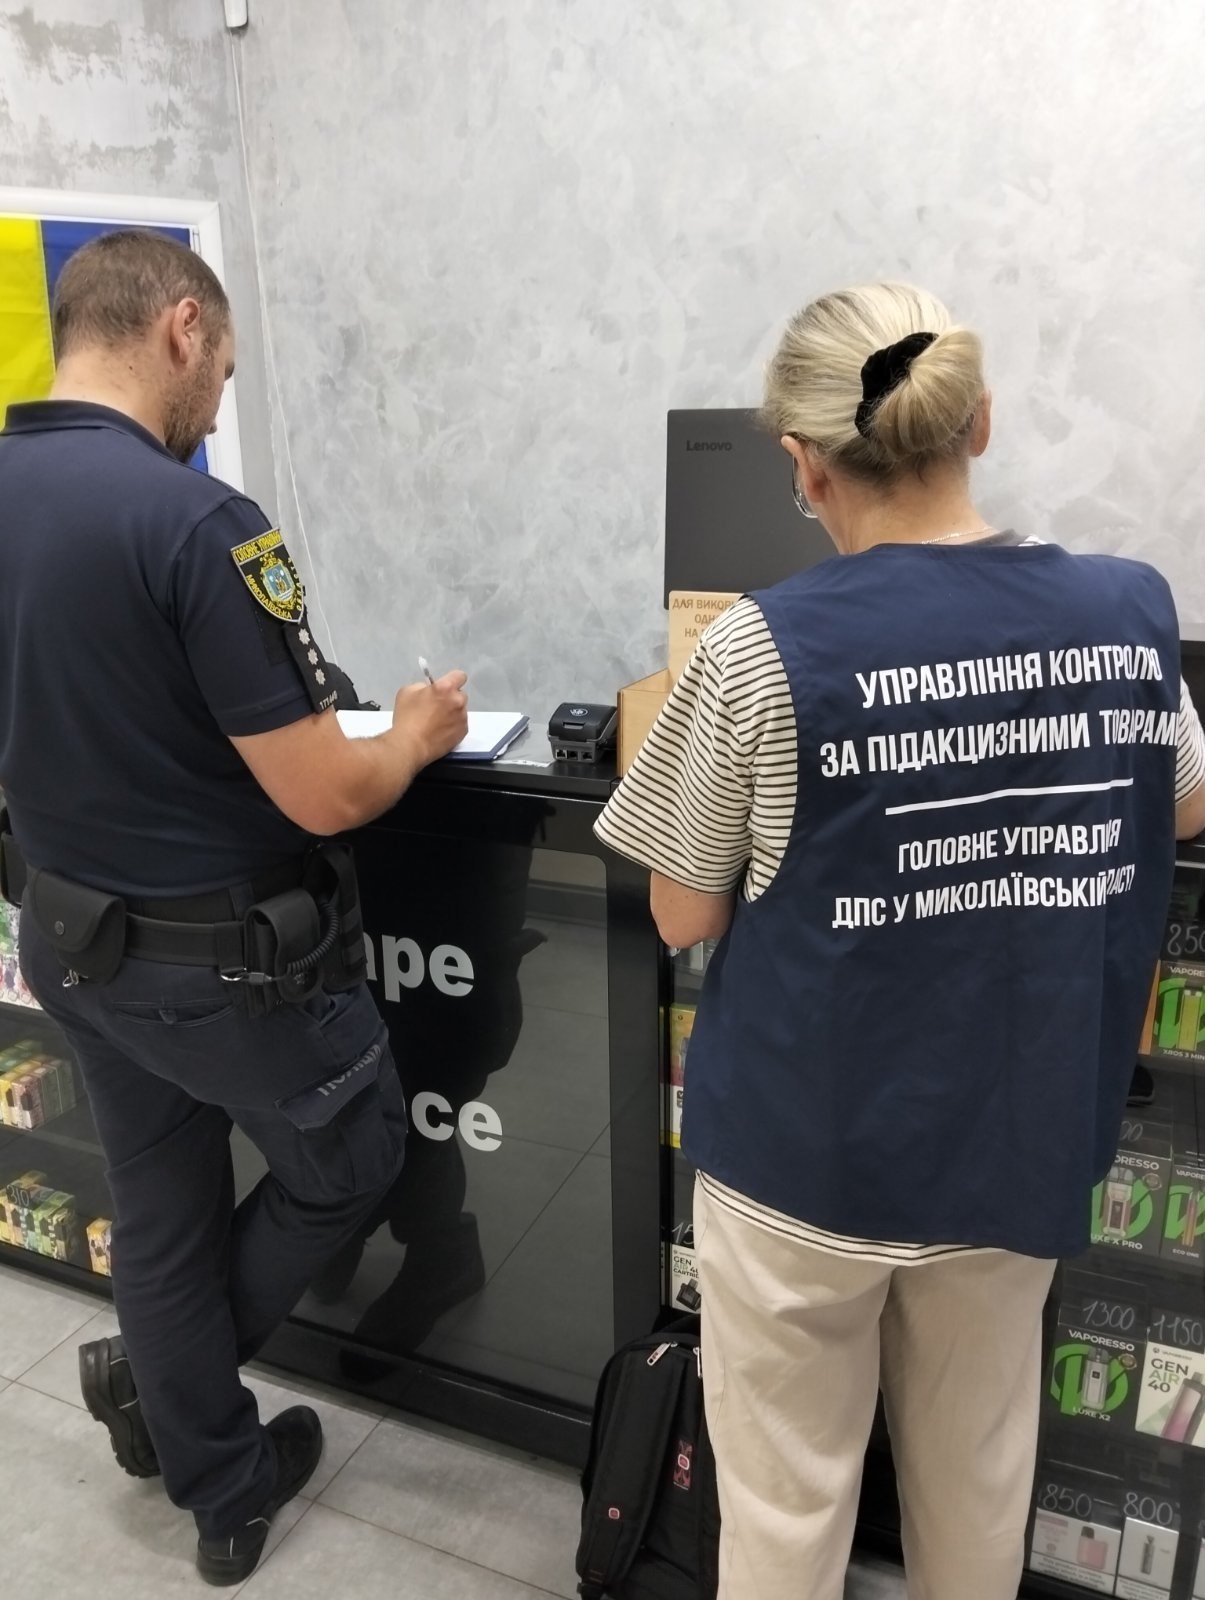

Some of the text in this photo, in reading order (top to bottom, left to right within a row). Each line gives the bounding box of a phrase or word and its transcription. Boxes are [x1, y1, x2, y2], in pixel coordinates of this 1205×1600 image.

[686, 440, 732, 451] Lenovo
[672, 598, 734, 610] ДЛЯ ВИКОР
[695, 613, 720, 625] ОДН
[684, 628, 698, 637] НА
[856, 645, 1163, 708] УПРАВЛІННЯ КОНТРОЛЮ
[820, 740, 860, 778] ЗА
[868, 712, 1090, 773] ПІДАКЦИЗНИМИ
[898, 829, 998, 873] ГОЛОВНЕ
[832, 897, 886, 929] ДПС
[893, 894, 910, 922] У
[915, 871, 1107, 920] МИКОЛАЇВСЬКІЙ
[403, 1091, 503, 1152] ce
[7, 1184, 30, 1208] 310
[1122, 1240, 1143, 1250] PRO
[673, 1256, 692, 1266] GEN
[1083, 1300, 1135, 1330] 1300
[1068, 1329, 1135, 1352] VAPORESSO
[1153, 1314, 1203, 1346] 1150
[1149, 1370, 1180, 1385] AIR
[1151, 1358, 1189, 1376] GEN
[1148, 1380, 1171, 1393] 40
[1072, 1406, 1111, 1421] LUXE X2
[1042, 1483, 1092, 1517] 850
[1123, 1491, 1173, 1526] 800
